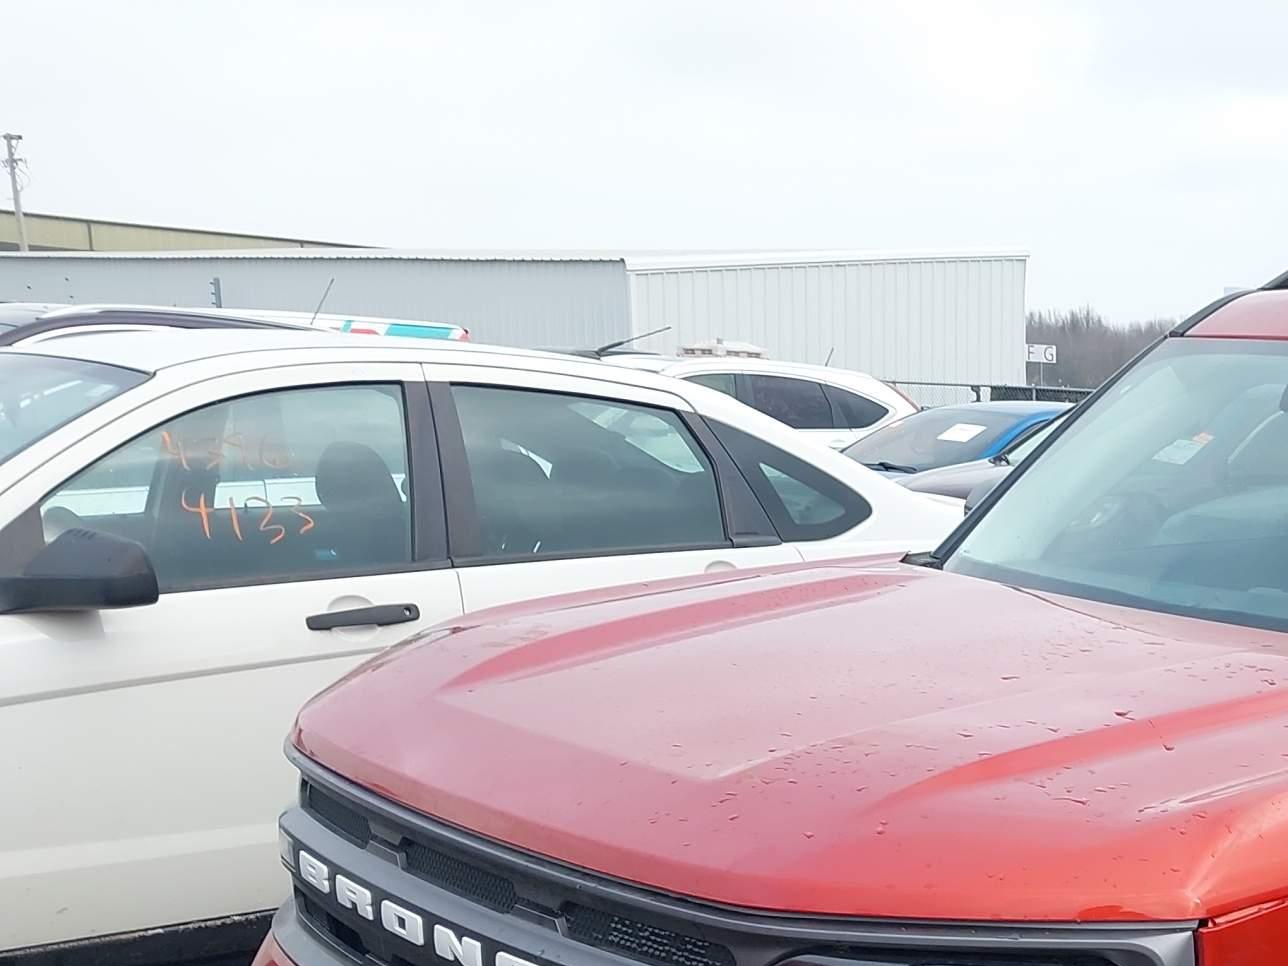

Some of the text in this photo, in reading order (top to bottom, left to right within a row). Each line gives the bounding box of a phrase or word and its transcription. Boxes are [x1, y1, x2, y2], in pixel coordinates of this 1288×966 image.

[1027, 344, 1054, 362] F G
[182, 489, 315, 545] 4133
